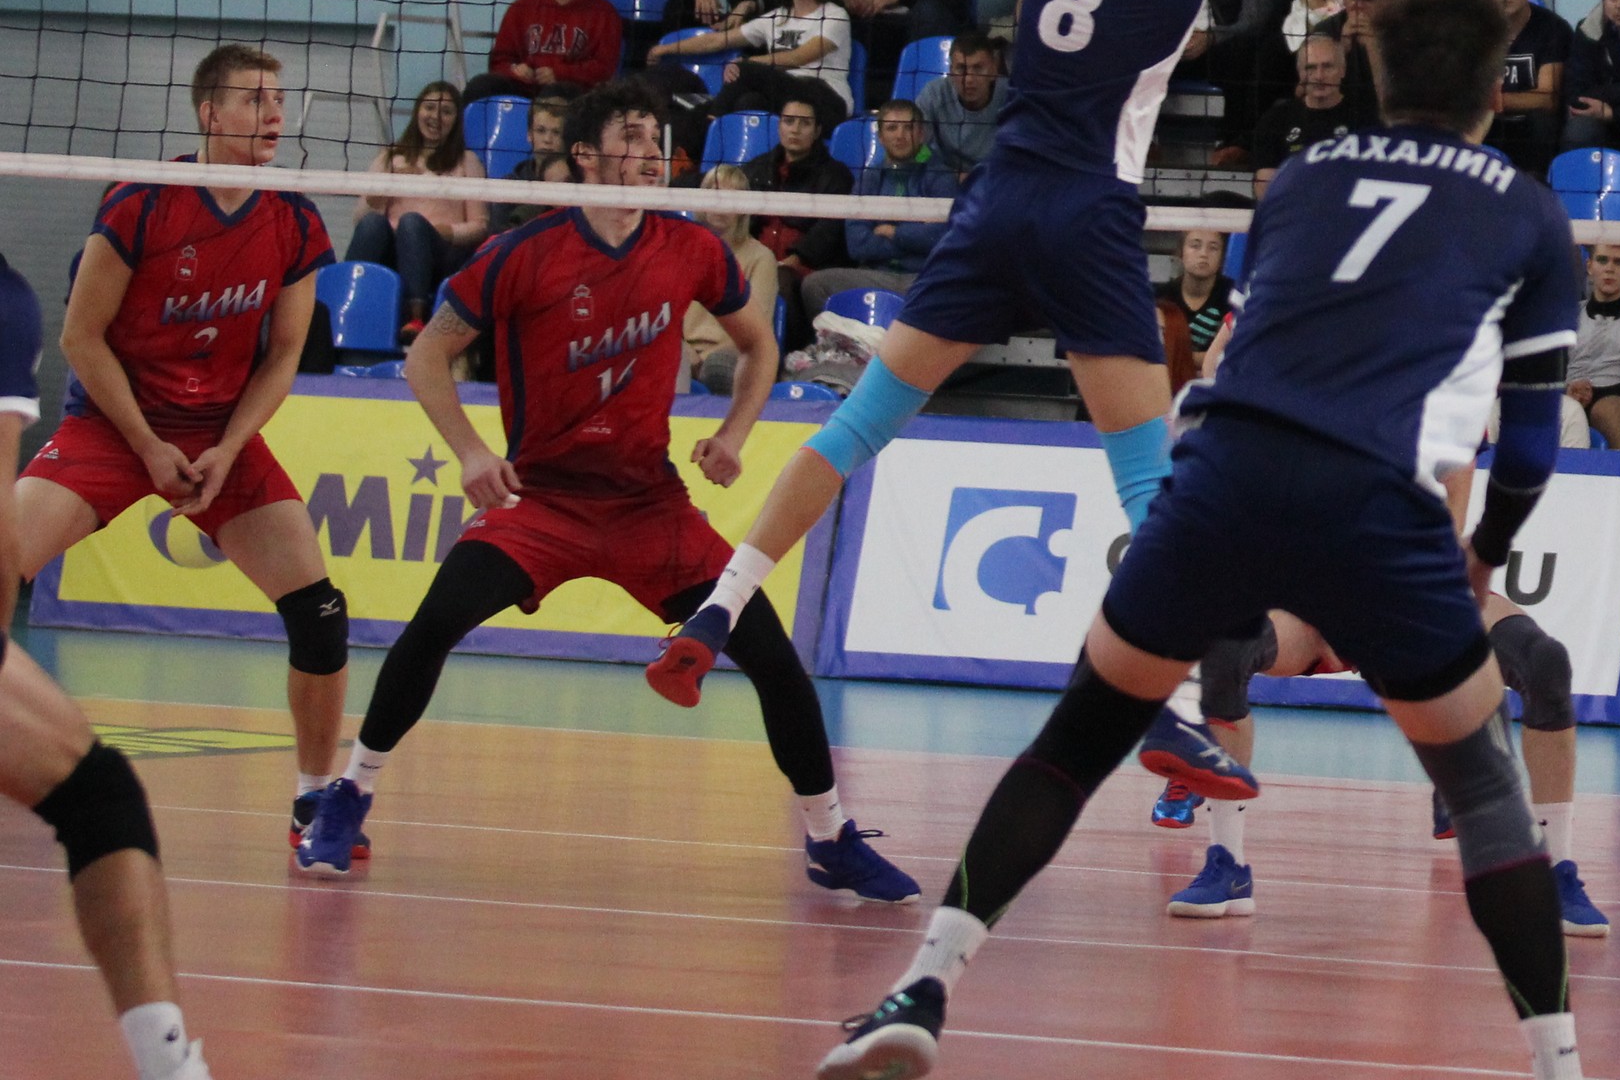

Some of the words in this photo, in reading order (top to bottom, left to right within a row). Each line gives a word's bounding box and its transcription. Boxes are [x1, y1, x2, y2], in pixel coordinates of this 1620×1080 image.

[1305, 134, 1517, 195] САХАЛИН
[1330, 177, 1432, 282] 7
[161, 279, 267, 324] КАМА
[188, 326, 218, 360] 2
[568, 301, 671, 372] КАМА
